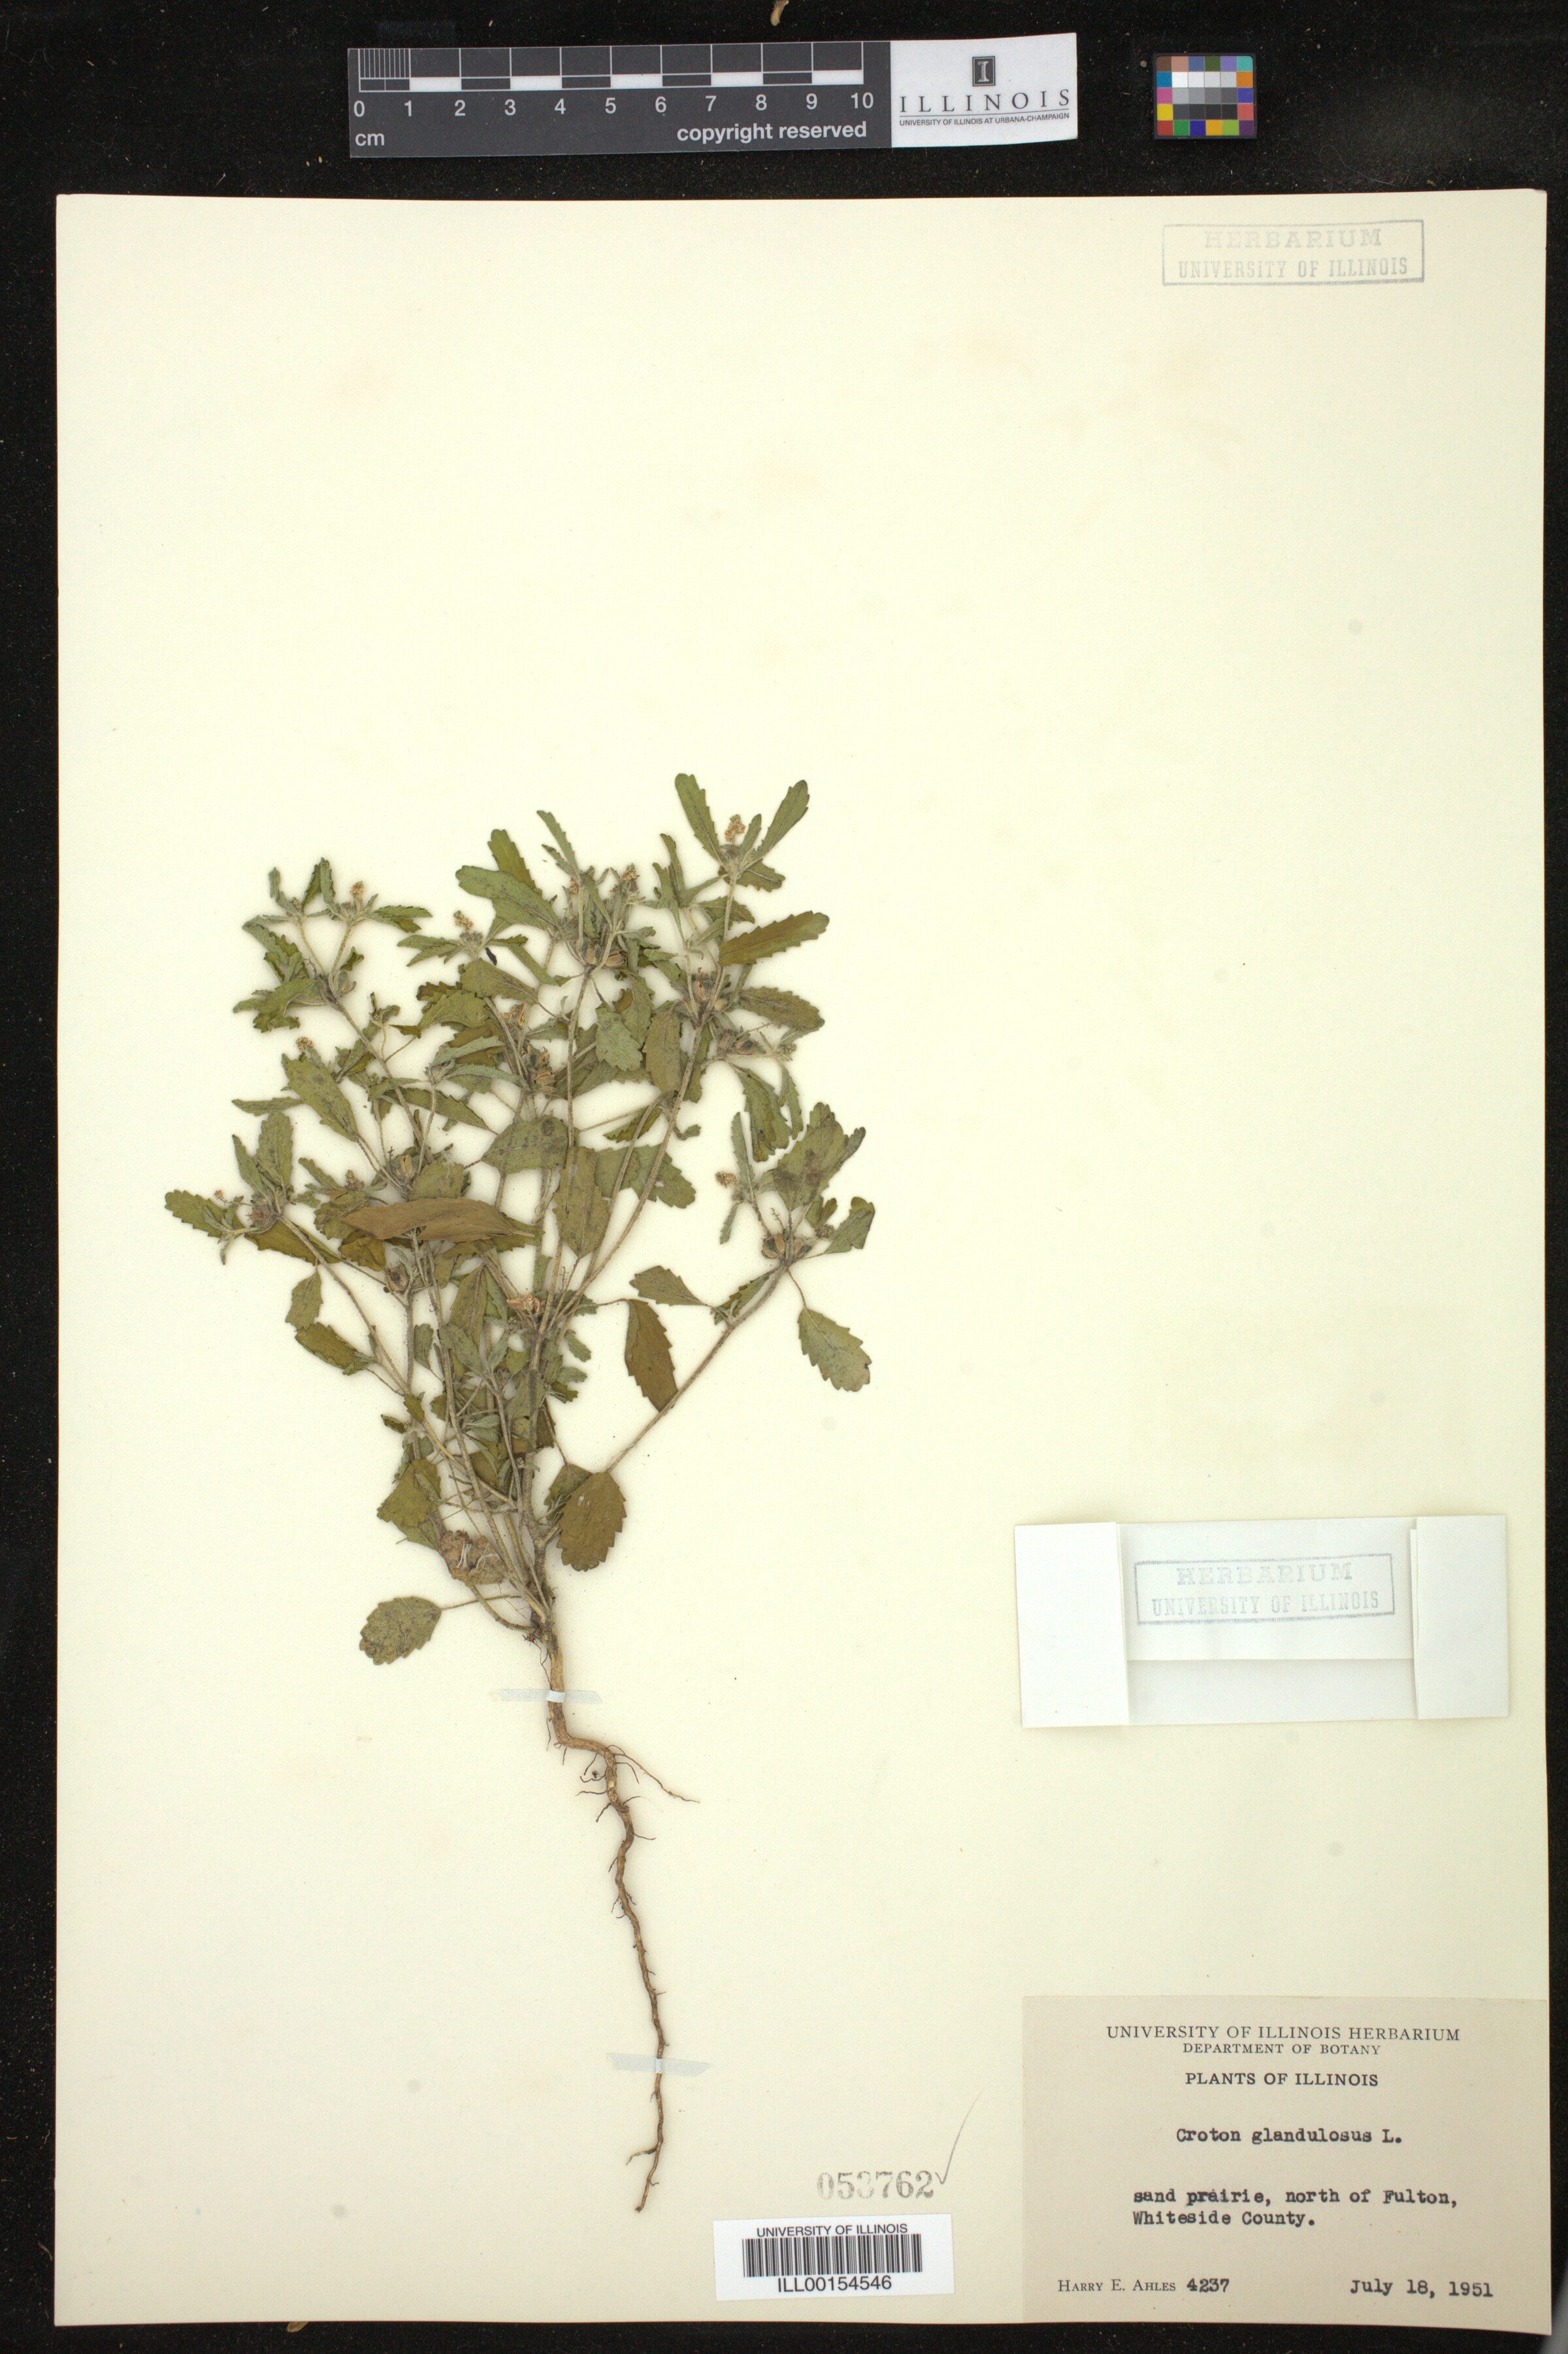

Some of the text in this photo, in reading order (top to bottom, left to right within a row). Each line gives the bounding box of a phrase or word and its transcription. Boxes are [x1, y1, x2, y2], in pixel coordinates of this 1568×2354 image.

[354, 92, 874, 117] 0 1 2 3 4 5 6 7 8 9 10
[900, 89, 1070, 112] ILLINOIS
[995, 112, 1070, 123] URBANA-CHAMPAIGN
[355, 133, 384, 146] cm
[678, 121, 866, 144] copyright reserved
[1204, 229, 1382, 249] HERBARIUM
[1179, 257, 1408, 279] UNIVERSITY OF ILLINOIS
[1177, 1563, 1353, 1586] HERBARIUM
[1152, 1591, 1379, 1616] UNIVERSITY OF ILLINOIS
[1107, 2026, 1459, 2040] UNIVERSITY OF ILLINOIS HERBARIUM
[1184, 2044, 1380, 2054] DEPARTMENT OF BOTANY
[1186, 2073, 1378, 2086] PLANTS OF ILLINOIS
[1177, 2128, 1401, 2144] Croton glandulosus L.
[817, 2170, 934, 2200] 053762
[1134, 2189, 1456, 2208] sand prairie, north of Fulton,
[1134, 2210, 1315, 2227] Whiteside County.
[757, 2223, 907, 2237] UNIVERSITY OF ILLINOIS
[777, 2275, 892, 2293] ILL00154546
[1112, 2279, 1125, 2291] E.
[1187, 2279, 1229, 2293] 4237
[1350, 2278, 1493, 2299] July 18, 1951
